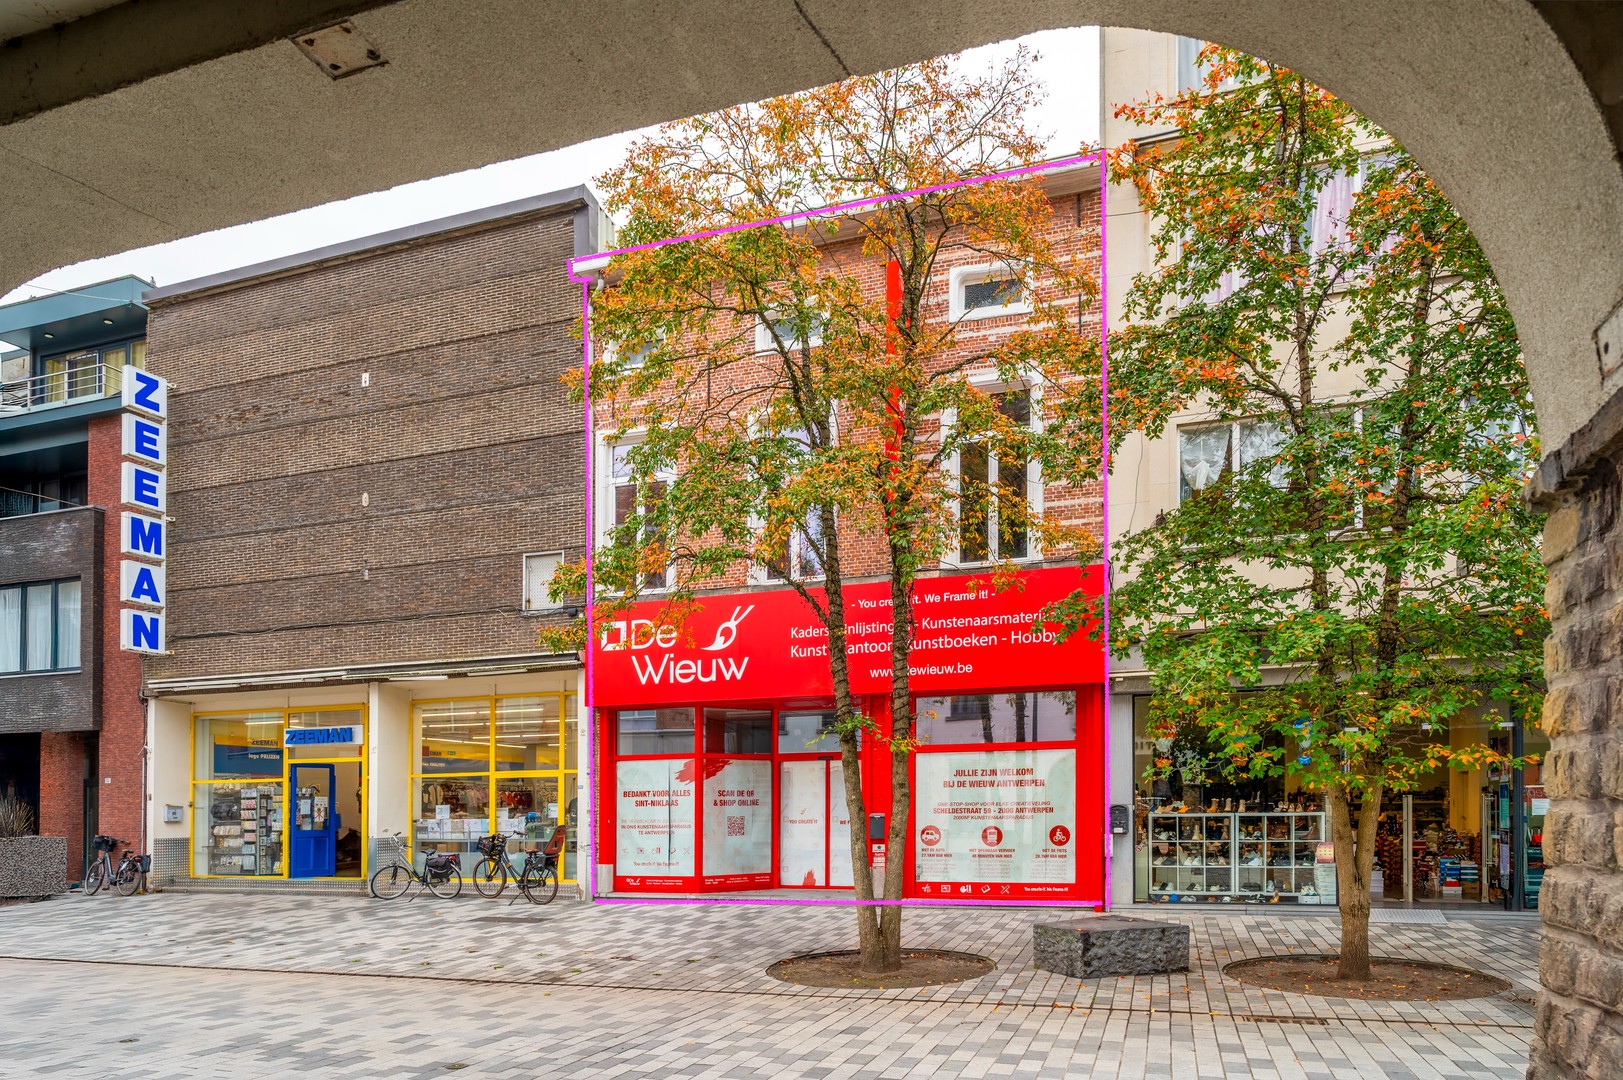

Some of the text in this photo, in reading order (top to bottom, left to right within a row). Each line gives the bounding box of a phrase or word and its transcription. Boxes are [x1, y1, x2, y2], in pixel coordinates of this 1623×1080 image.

[130, 372, 162, 650] ZEEMAN
[858, 599, 876, 608] You
[912, 594, 922, 604] it.
[924, 594, 940, 603] We
[944, 592, 976, 602] Frame
[978, 590, 988, 599] it!
[791, 626, 829, 638] Kaders
[845, 622, 904, 637] nlijsting
[922, 610, 1053, 630] Kunstenaarsmateri
[631, 619, 676, 650] De
[791, 644, 827, 658] Kunst
[845, 640, 892, 655] antoor
[631, 653, 749, 685] Wieuw
[870, 662, 972, 678] wwwewieuw.be
[251, 739, 278, 747] ZEEMAN
[285, 728, 352, 744] ZEEMAN
[954, 768, 1034, 777] JULLIE ZIJN WELKOM
[996, 779, 1045, 788] ANTWERPEN
[623, 790, 651, 798] BEDANKT
[634, 800, 678, 808] SINT-NIKLAAS
